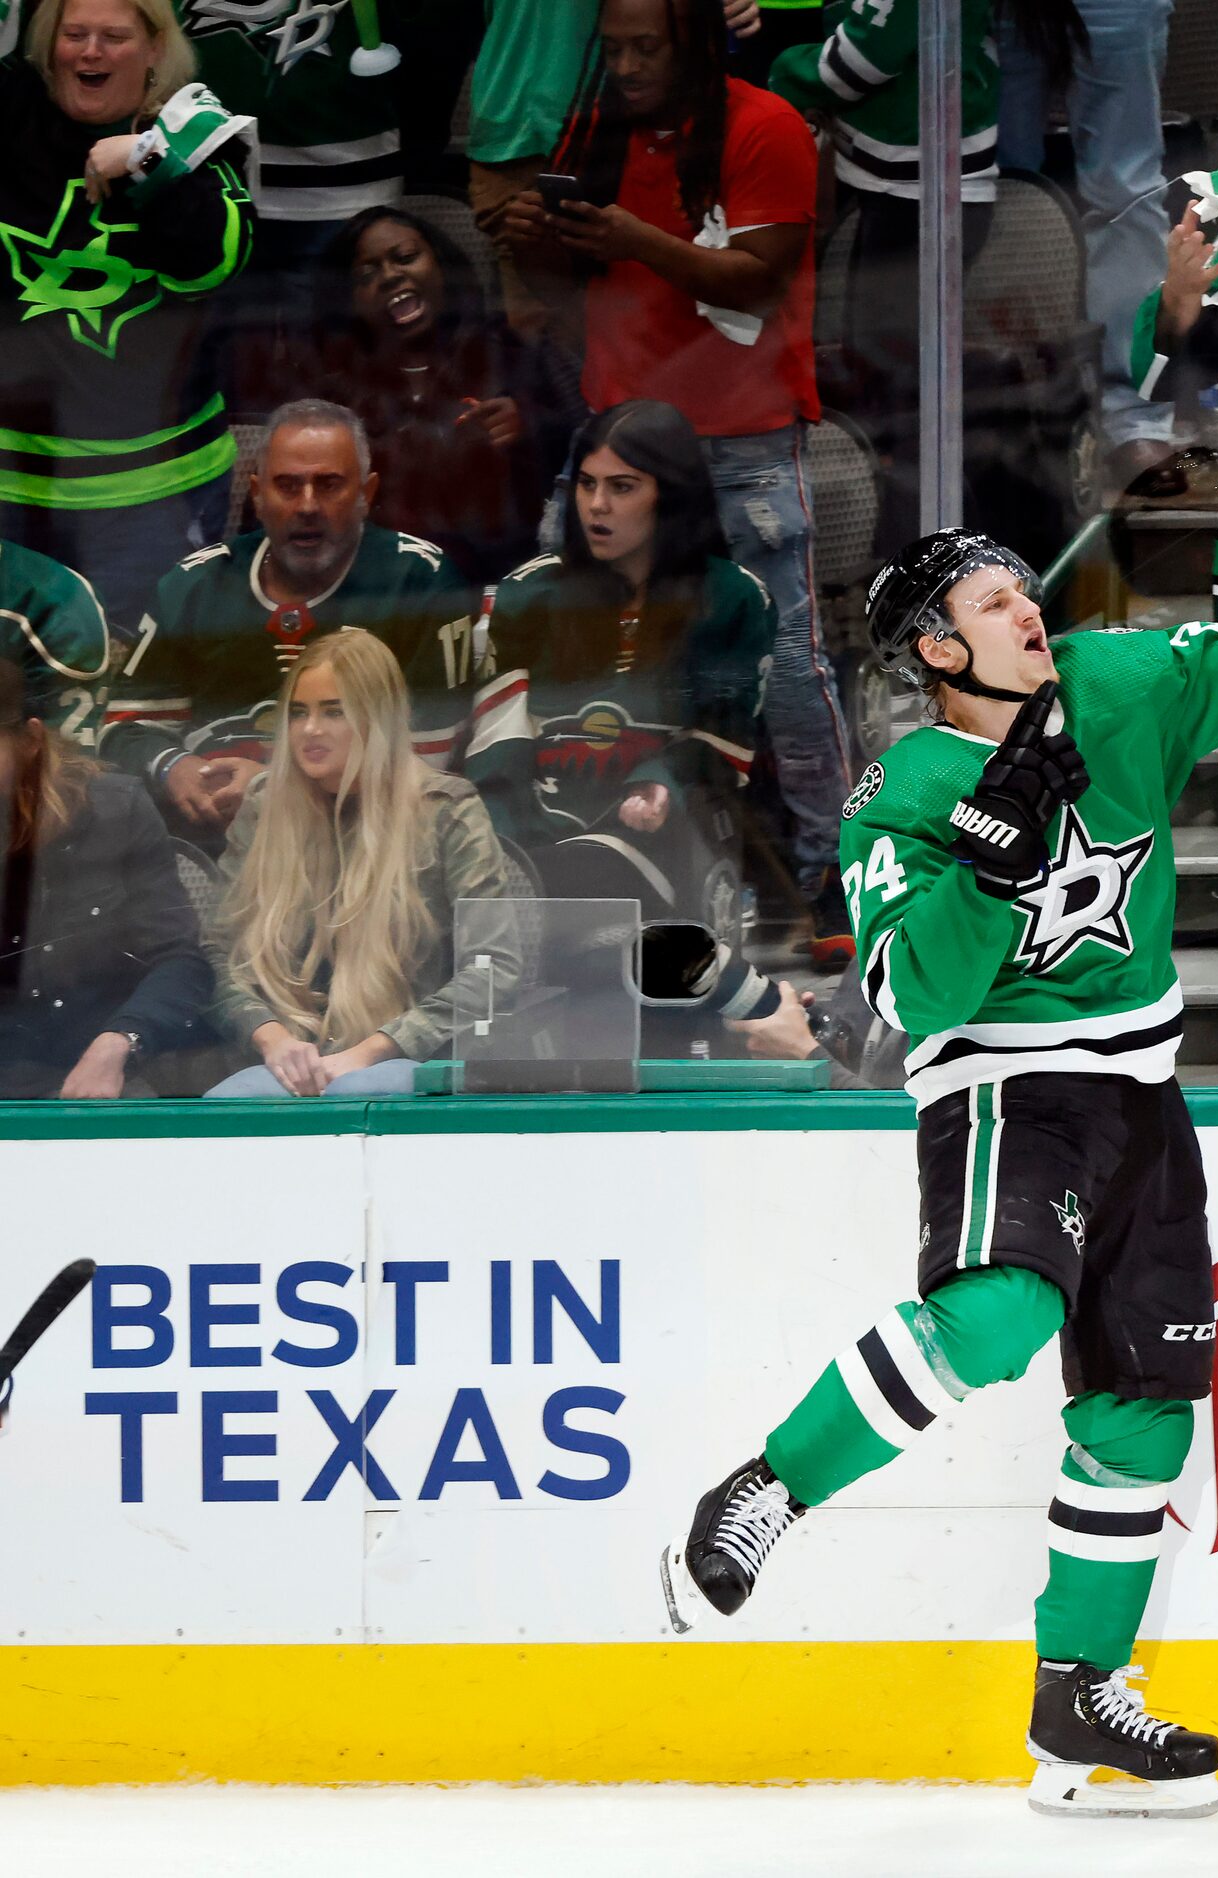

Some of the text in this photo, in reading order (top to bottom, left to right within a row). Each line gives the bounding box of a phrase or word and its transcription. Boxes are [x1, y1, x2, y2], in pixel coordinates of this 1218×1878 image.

[437, 614, 471, 689] 17
[91, 1258, 623, 1370] BEST IN
[84, 1385, 632, 1504] TEXAS
